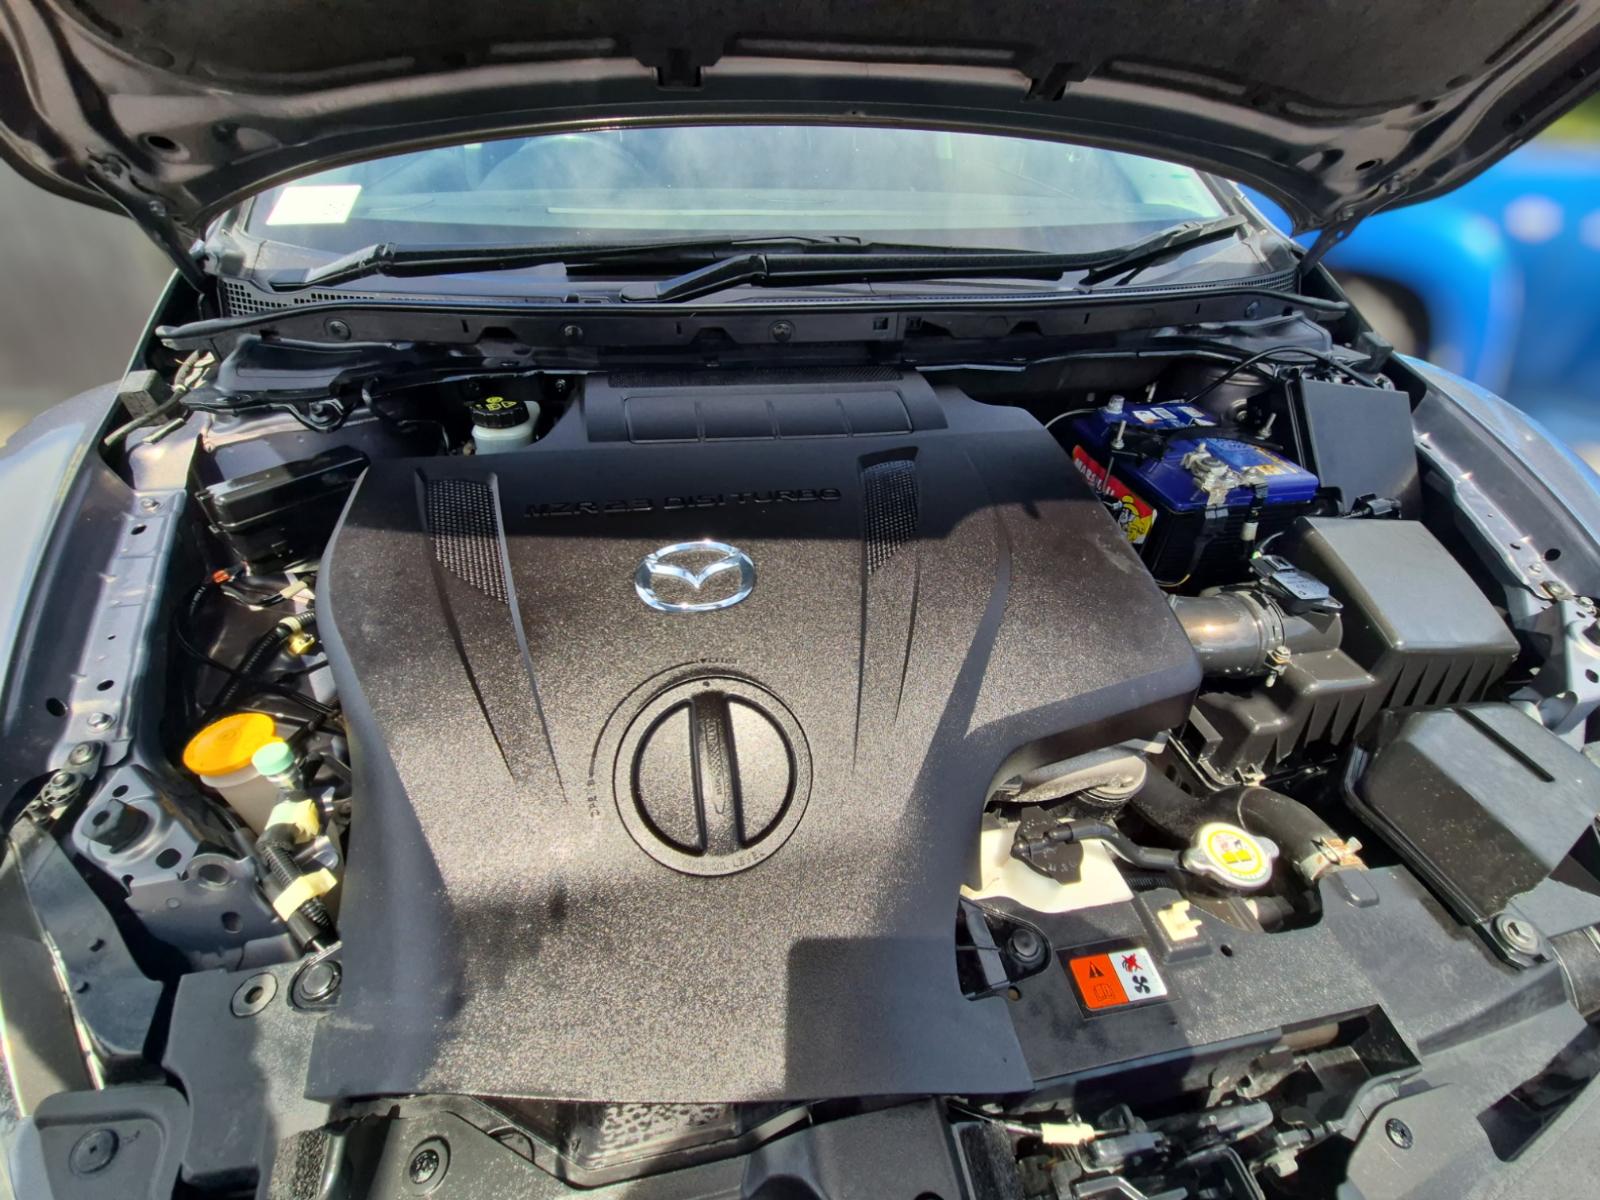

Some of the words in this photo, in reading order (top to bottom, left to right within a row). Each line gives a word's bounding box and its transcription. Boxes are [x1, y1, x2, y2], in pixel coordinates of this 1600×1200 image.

[1073, 457, 1115, 496] MARSLL
[525, 502, 600, 518] MZR
[663, 493, 725, 510] DISI
[729, 487, 842, 505] TURBO
